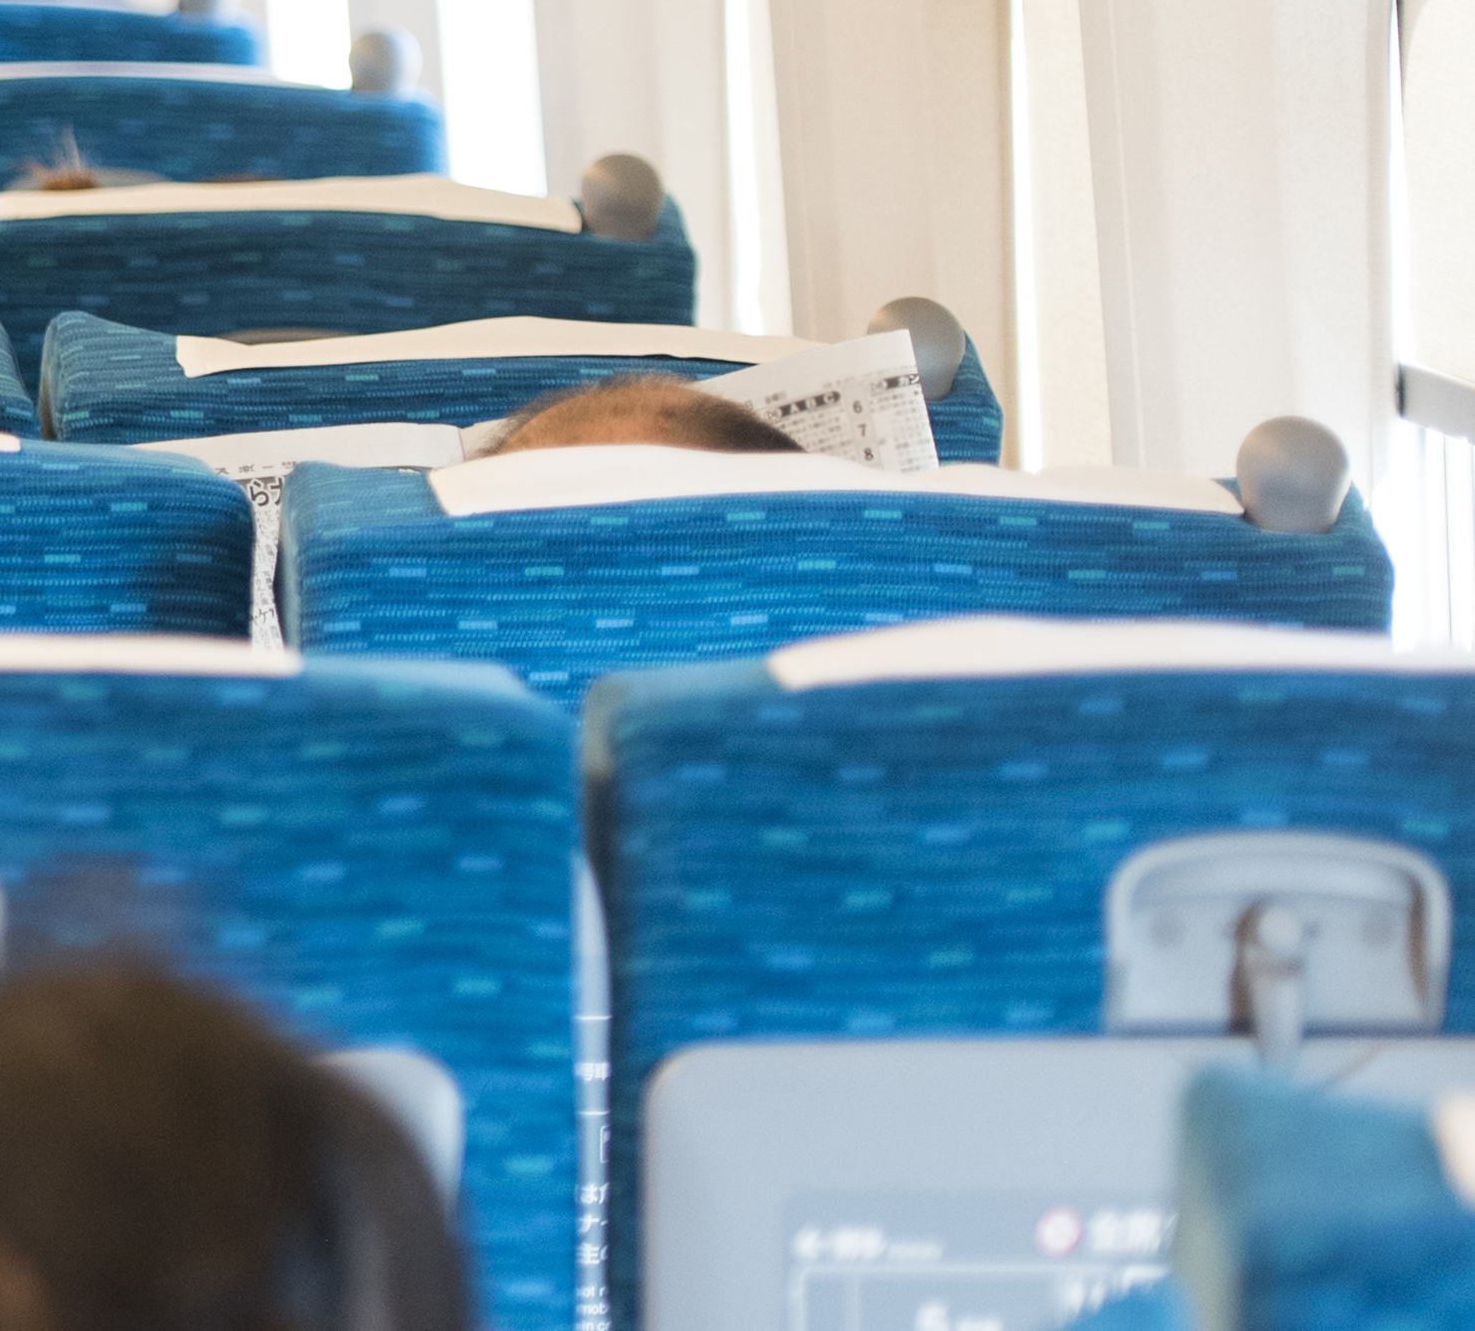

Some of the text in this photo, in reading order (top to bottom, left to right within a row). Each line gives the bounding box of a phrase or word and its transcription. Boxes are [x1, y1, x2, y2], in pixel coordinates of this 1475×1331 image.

[852, 401, 863, 414] 6
[858, 423, 867, 437] 7
[864, 447, 873, 461] 8
